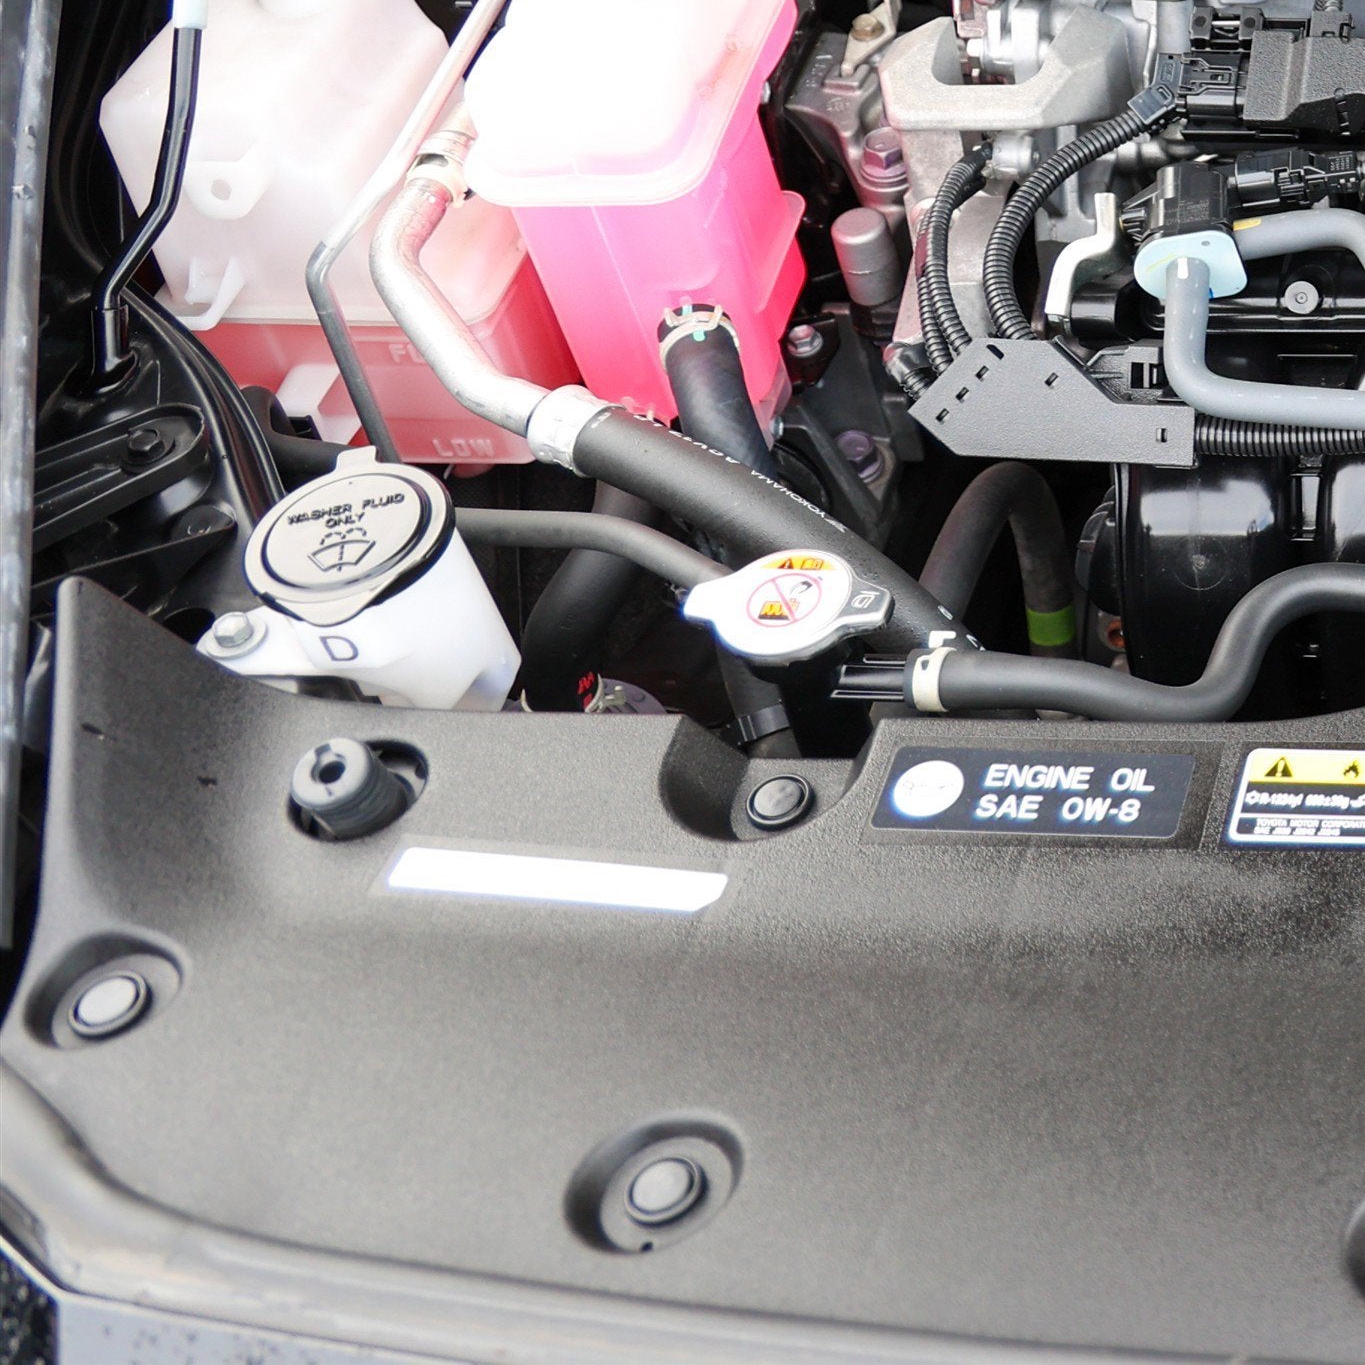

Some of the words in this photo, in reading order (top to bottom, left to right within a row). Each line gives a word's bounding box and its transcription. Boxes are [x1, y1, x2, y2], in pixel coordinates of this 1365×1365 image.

[433, 438, 495, 458] LOW
[750, 468, 829, 520] YOKOHAMA
[288, 503, 353, 526] WASHER
[362, 493, 406, 510] FLUID
[325, 511, 366, 529] ONLY
[318, 635, 360, 662] D
[984, 763, 1095, 791] ENGINE
[1110, 767, 1156, 792] OIL
[975, 794, 1044, 820] SAE
[1255, 817, 1288, 828] TOYOTA
[1289, 818, 1319, 828] MOTOR
